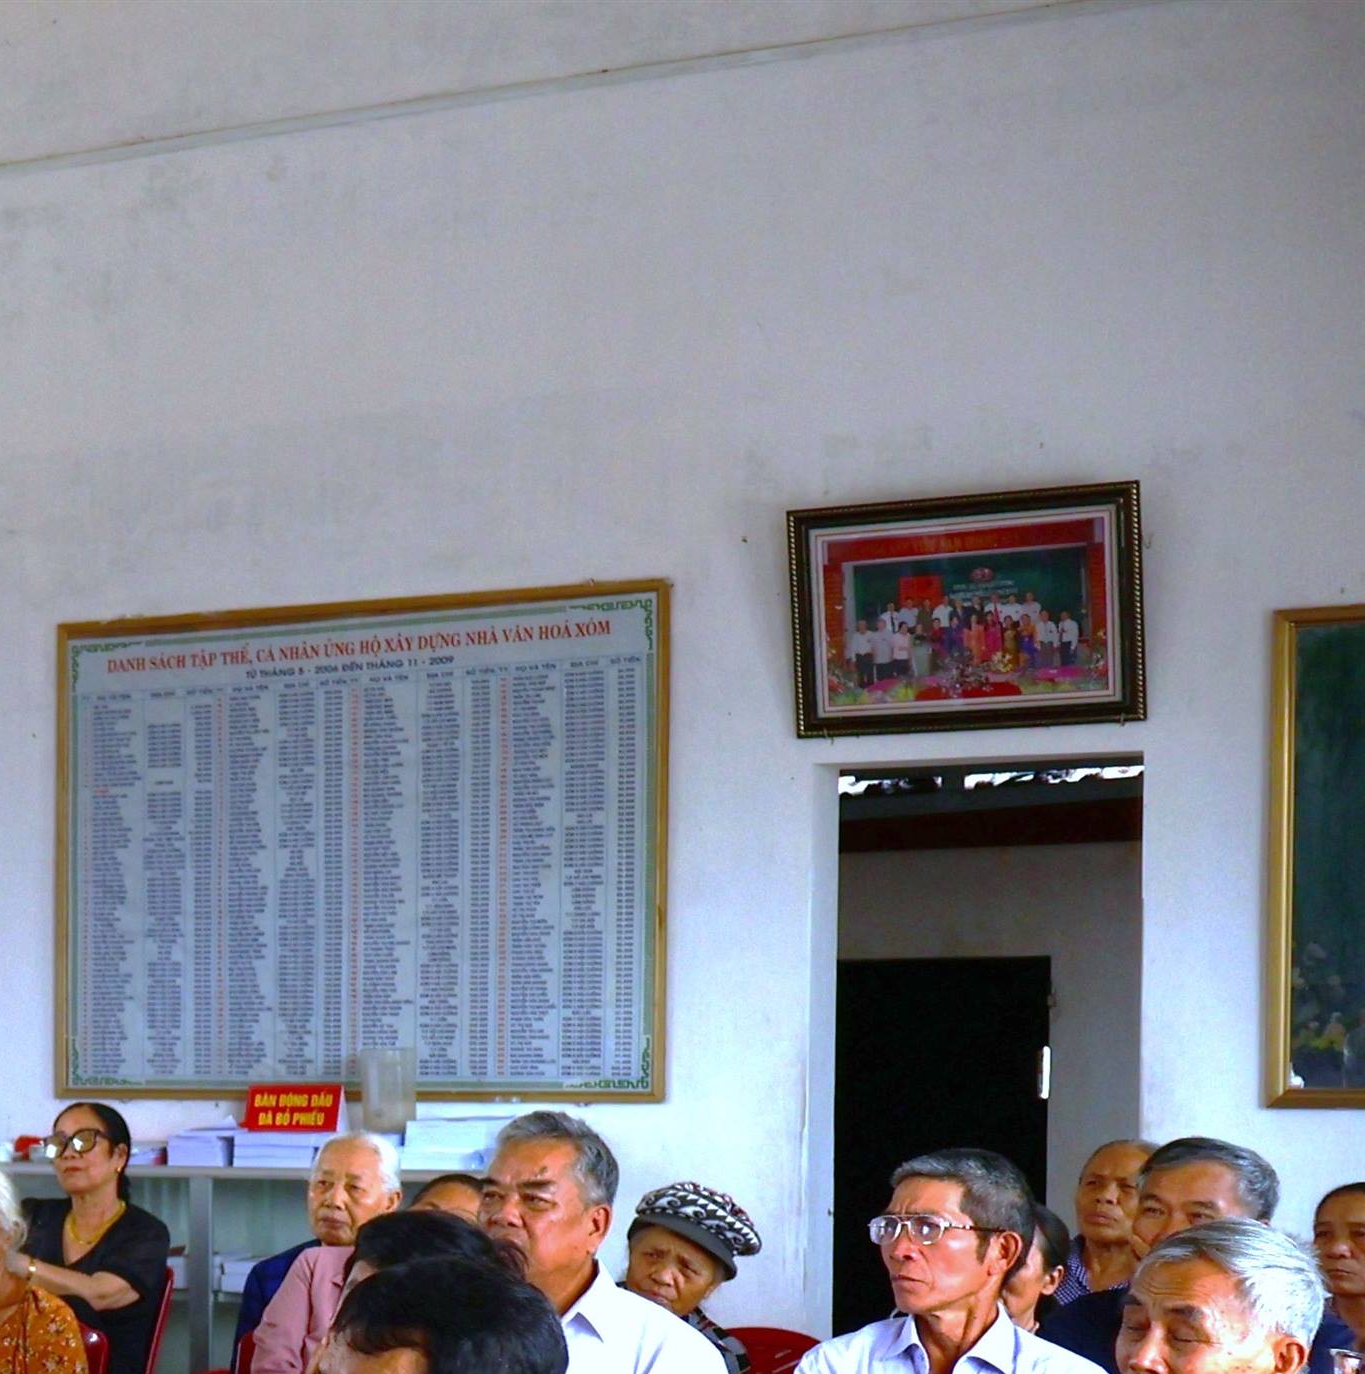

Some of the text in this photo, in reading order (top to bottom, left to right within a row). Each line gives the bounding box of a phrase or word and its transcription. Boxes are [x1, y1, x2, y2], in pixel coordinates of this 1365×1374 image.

[107, 657, 146, 674] DANH
[149, 651, 186, 670] SÁCH
[191, 649, 217, 671] TẬP
[279, 641, 320, 661] NHÂN
[359, 635, 382, 655] HỘ
[383, 632, 414, 651] XÂY
[418, 631, 461, 653] DỰNG
[465, 625, 498, 646] NHÀ
[502, 622, 535, 642] VĂN
[574, 620, 611, 636] XÓM
[260, 665, 295, 678] THÁNG
[366, 656, 403, 671] THÁNG
[429, 655, 454, 666] 2009
